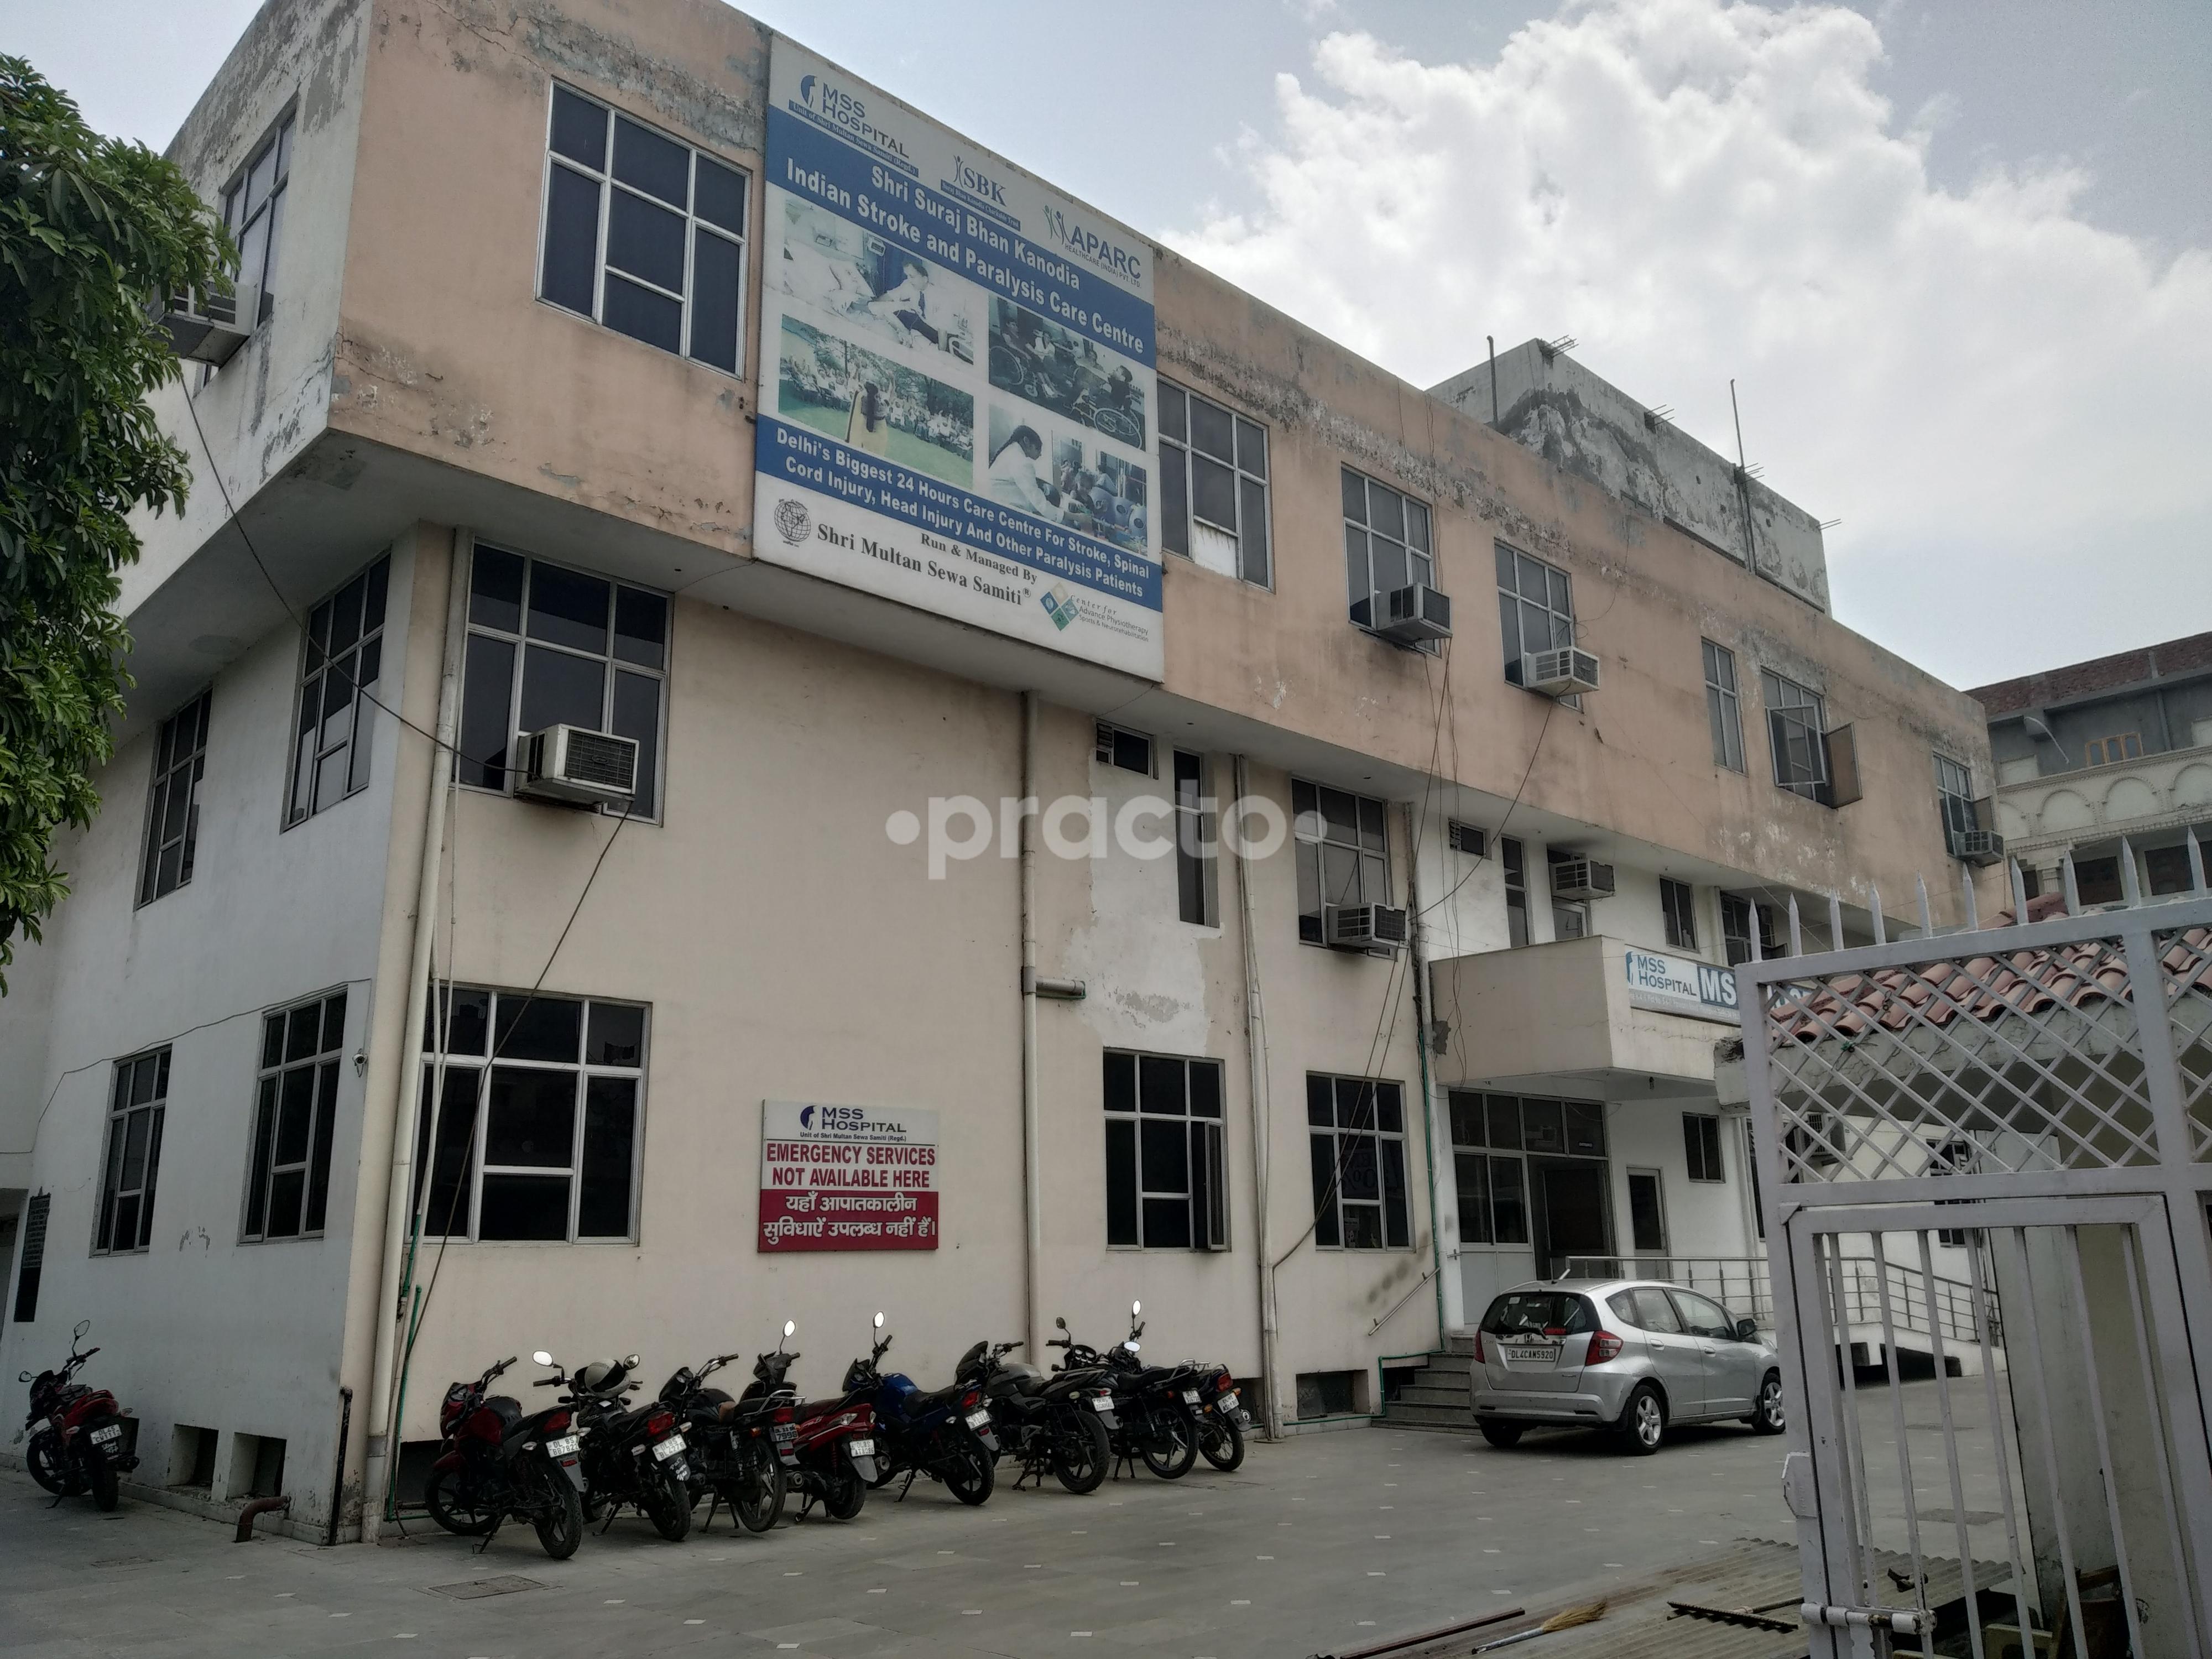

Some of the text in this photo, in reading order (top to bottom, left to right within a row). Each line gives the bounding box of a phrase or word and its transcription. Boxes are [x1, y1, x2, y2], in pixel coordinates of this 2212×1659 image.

[823, 82, 865, 118] MSS
[817, 113, 831, 128] Shri
[832, 124, 854, 142] Multan
[856, 136, 873, 152] Sewa
[822, 98, 909, 159] HOSPITAL
[964, 167, 1006, 207] SBK
[872, 166, 1080, 290] Shri Suraj Bhan Kanodia
[787, 157, 1144, 354] Indian Stroke and Paralysis Care Centre
[1065, 243, 1100, 266] HEALTHCARE
[1100, 262, 1118, 278] (INDIA)
[1071, 226, 1141, 279] APARC
[777, 427, 1150, 579] Delhi's Biggest 24 Hours Care Centre For Stroke, Spinal
[785, 456, 823, 483] Cord
[828, 471, 877, 505] Injury,
[881, 490, 918, 517] Head
[922, 505, 963, 536] Injury
[967, 522, 992, 544] And
[996, 533, 1033, 557] Other
[1036, 546, 1092, 580] Paralysis
[1095, 567, 1143, 598] Patients
[817, 523, 855, 551] Shri
[861, 537, 922, 573] Multan
[927, 560, 968, 588] Sewa
[921, 533, 1037, 585] Run & Managed By
[1070, 594, 1117, 615] Center for
[1079, 614, 1095, 625] Sports
[1079, 606, 1149, 636] Advance Physiotherapy
[1637, 955, 1666, 974] MSS
[1639, 971, 1697, 997] HOSPITAL
[1699, 967, 1738, 1006] MS
[822, 1107, 864, 1120] MSS
[822, 1118, 907, 1133] HOSPITAL
[766, 1143, 935, 1165] EMERGENCY SERVICES
[773, 1167, 930, 1187] NOT AVAILABLE HERE
[785, 1191, 917, 1212] यहाँ आपातकालीन
[828, 1222, 883, 1237] उपलब्ध
[885, 1216, 916, 1237] नहीं
